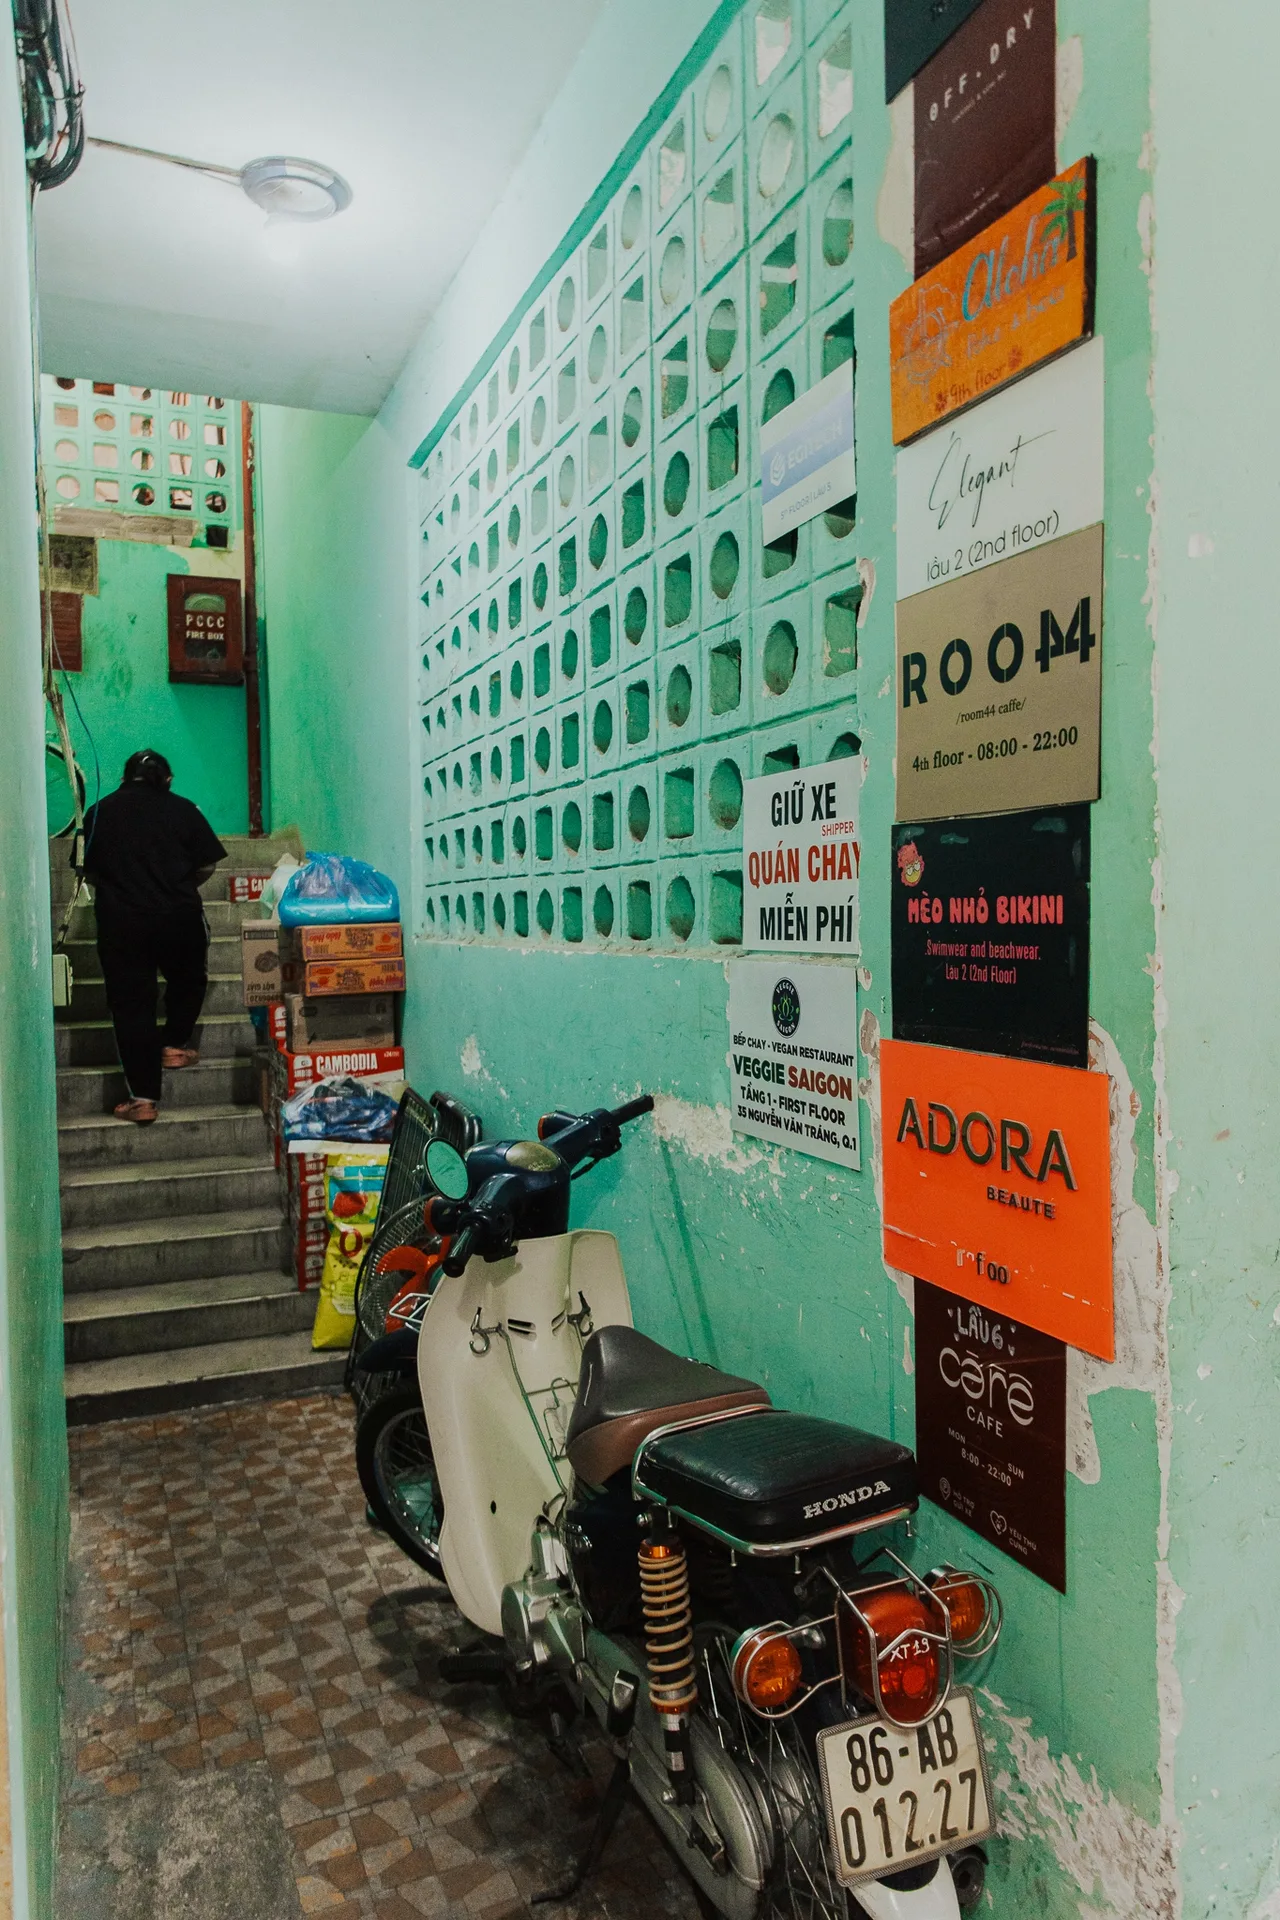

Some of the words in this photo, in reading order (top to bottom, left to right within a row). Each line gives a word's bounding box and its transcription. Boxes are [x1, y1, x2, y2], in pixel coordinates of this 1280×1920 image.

[975, 363, 1006, 391] floor
[926, 556, 950, 582] lầu
[954, 549, 964, 571] 2
[968, 530, 1006, 567] (2nd
[1012, 510, 1060, 546] floor)
[185, 613, 225, 629] PCCC
[185, 630, 205, 640] FIRE
[207, 631, 225, 641] BOX
[955, 706, 996, 726] /room44
[998, 696, 1027, 717] caffe/
[912, 755, 930, 772] 4th
[933, 750, 964, 770] floor
[977, 737, 1018, 762] 08:00
[1033, 726, 1078, 752] 22:00
[771, 780, 805, 828] GIỮ
[811, 782, 837, 822] XE
[821, 820, 854, 837] SHIPPER
[748, 841, 799, 889] QUÁN
[759, 892, 808, 942] MIỄN
[816, 895, 854, 943] PHÍ
[907, 890, 943, 924] MÈO
[949, 887, 989, 924] NHỎ
[996, 895, 1064, 925] BIKINI
[970, 941, 986, 959] and
[775, 981, 795, 997] VEGGIE
[961, 965, 967, 981] 2
[969, 965, 988, 983] (2nd
[990, 967, 1017, 985] Floor)
[316, 1052, 378, 1073] CAMBODIA
[733, 1030, 747, 1046] BẾP
[747, 1035, 766, 1051] CHAY
[772, 1040, 798, 1057] VEGAN
[799, 1046, 854, 1068] RESTAURANT
[733, 1054, 785, 1086] VEGGIE
[788, 1065, 853, 1102] SAIGON
[740, 1082, 766, 1105] TẦNG
[778, 1095, 807, 1116] FIRST
[808, 1104, 846, 1126] FLOOR
[737, 1105, 747, 1119] 35
[748, 1107, 782, 1128] NGUYỄN
[784, 1116, 803, 1135] VĂN
[804, 1124, 840, 1149] TRÁNG,
[842, 1134, 857, 1151] Q.1
[896, 1096, 1079, 1191] ADORA
[986, 1184, 1057, 1221] BEAUTE
[991, 1325, 1004, 1350] 6
[966, 1405, 1004, 1439] CAFE
[948, 1427, 966, 1445] MON
[1007, 1462, 1025, 1480] SUN
[961, 1447, 980, 1468] 8:00
[987, 1463, 1012, 1487] 22:00
[803, 1480, 891, 1520] HONDA
[845, 1707, 959, 1795] 86-AB
[840, 1767, 978, 1870] 012.27
